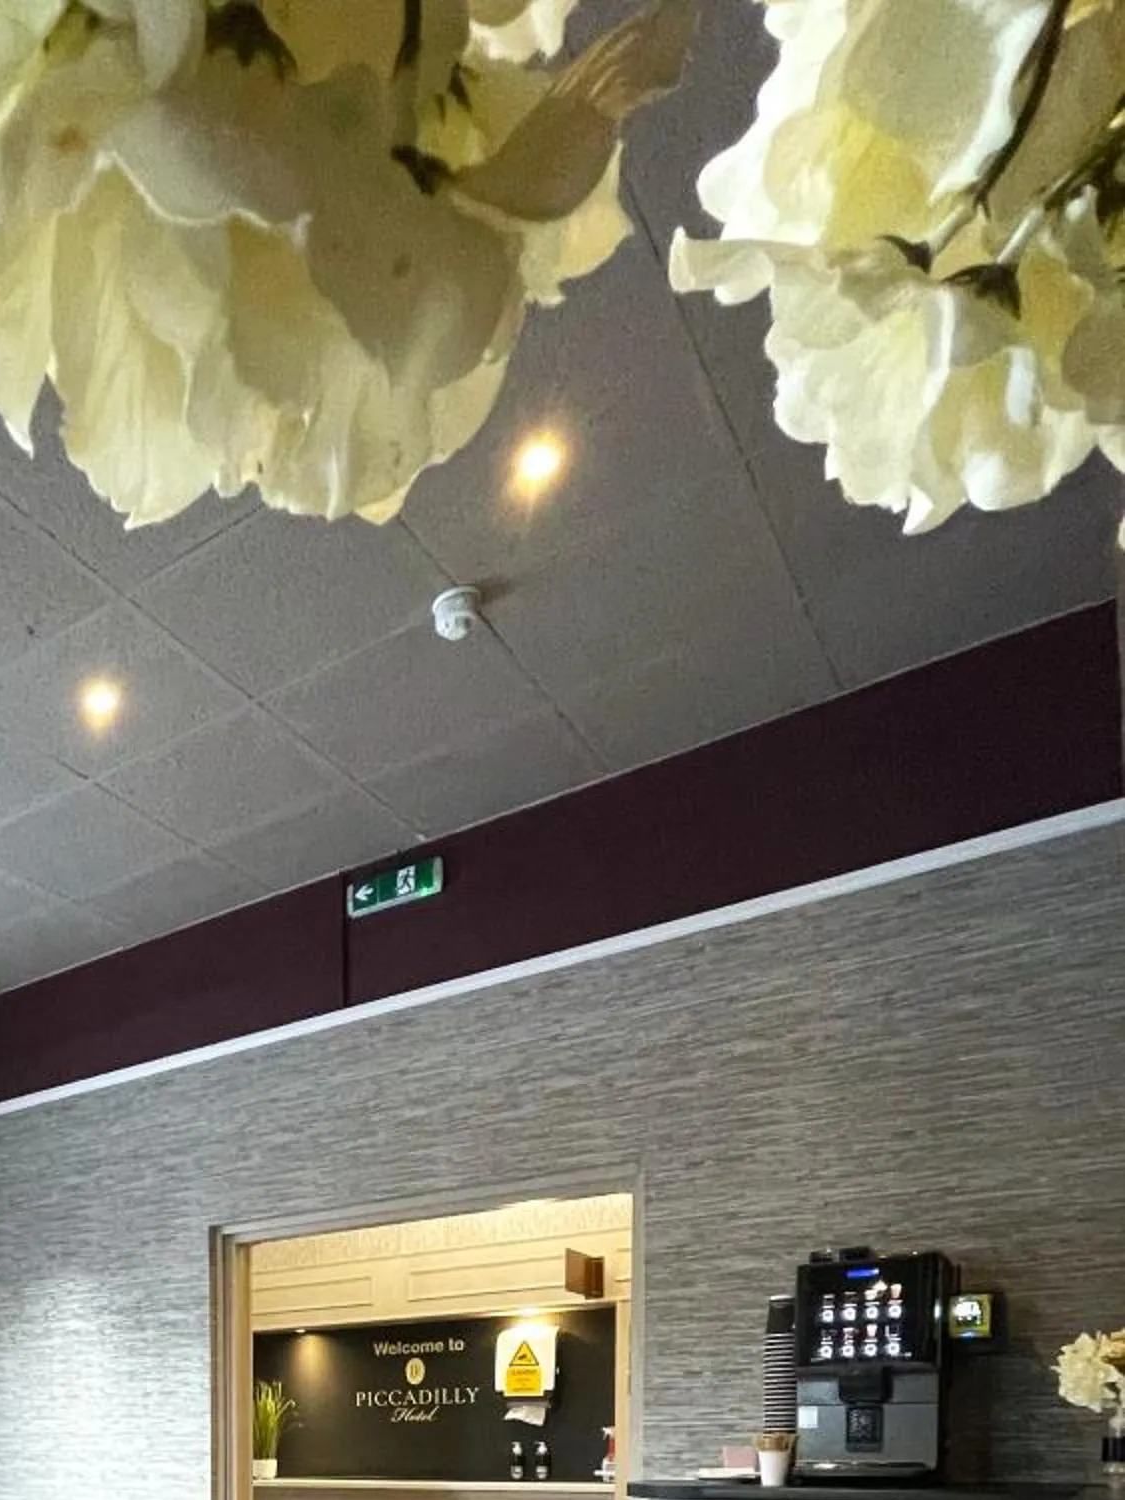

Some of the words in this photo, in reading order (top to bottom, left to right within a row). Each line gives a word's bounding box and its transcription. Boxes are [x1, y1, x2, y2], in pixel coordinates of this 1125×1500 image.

[373, 1341, 444, 1356] Welcome
[448, 1337, 465, 1351] to
[355, 1386, 479, 1407] PICCADILLY
[391, 1405, 440, 1422] Hotel
